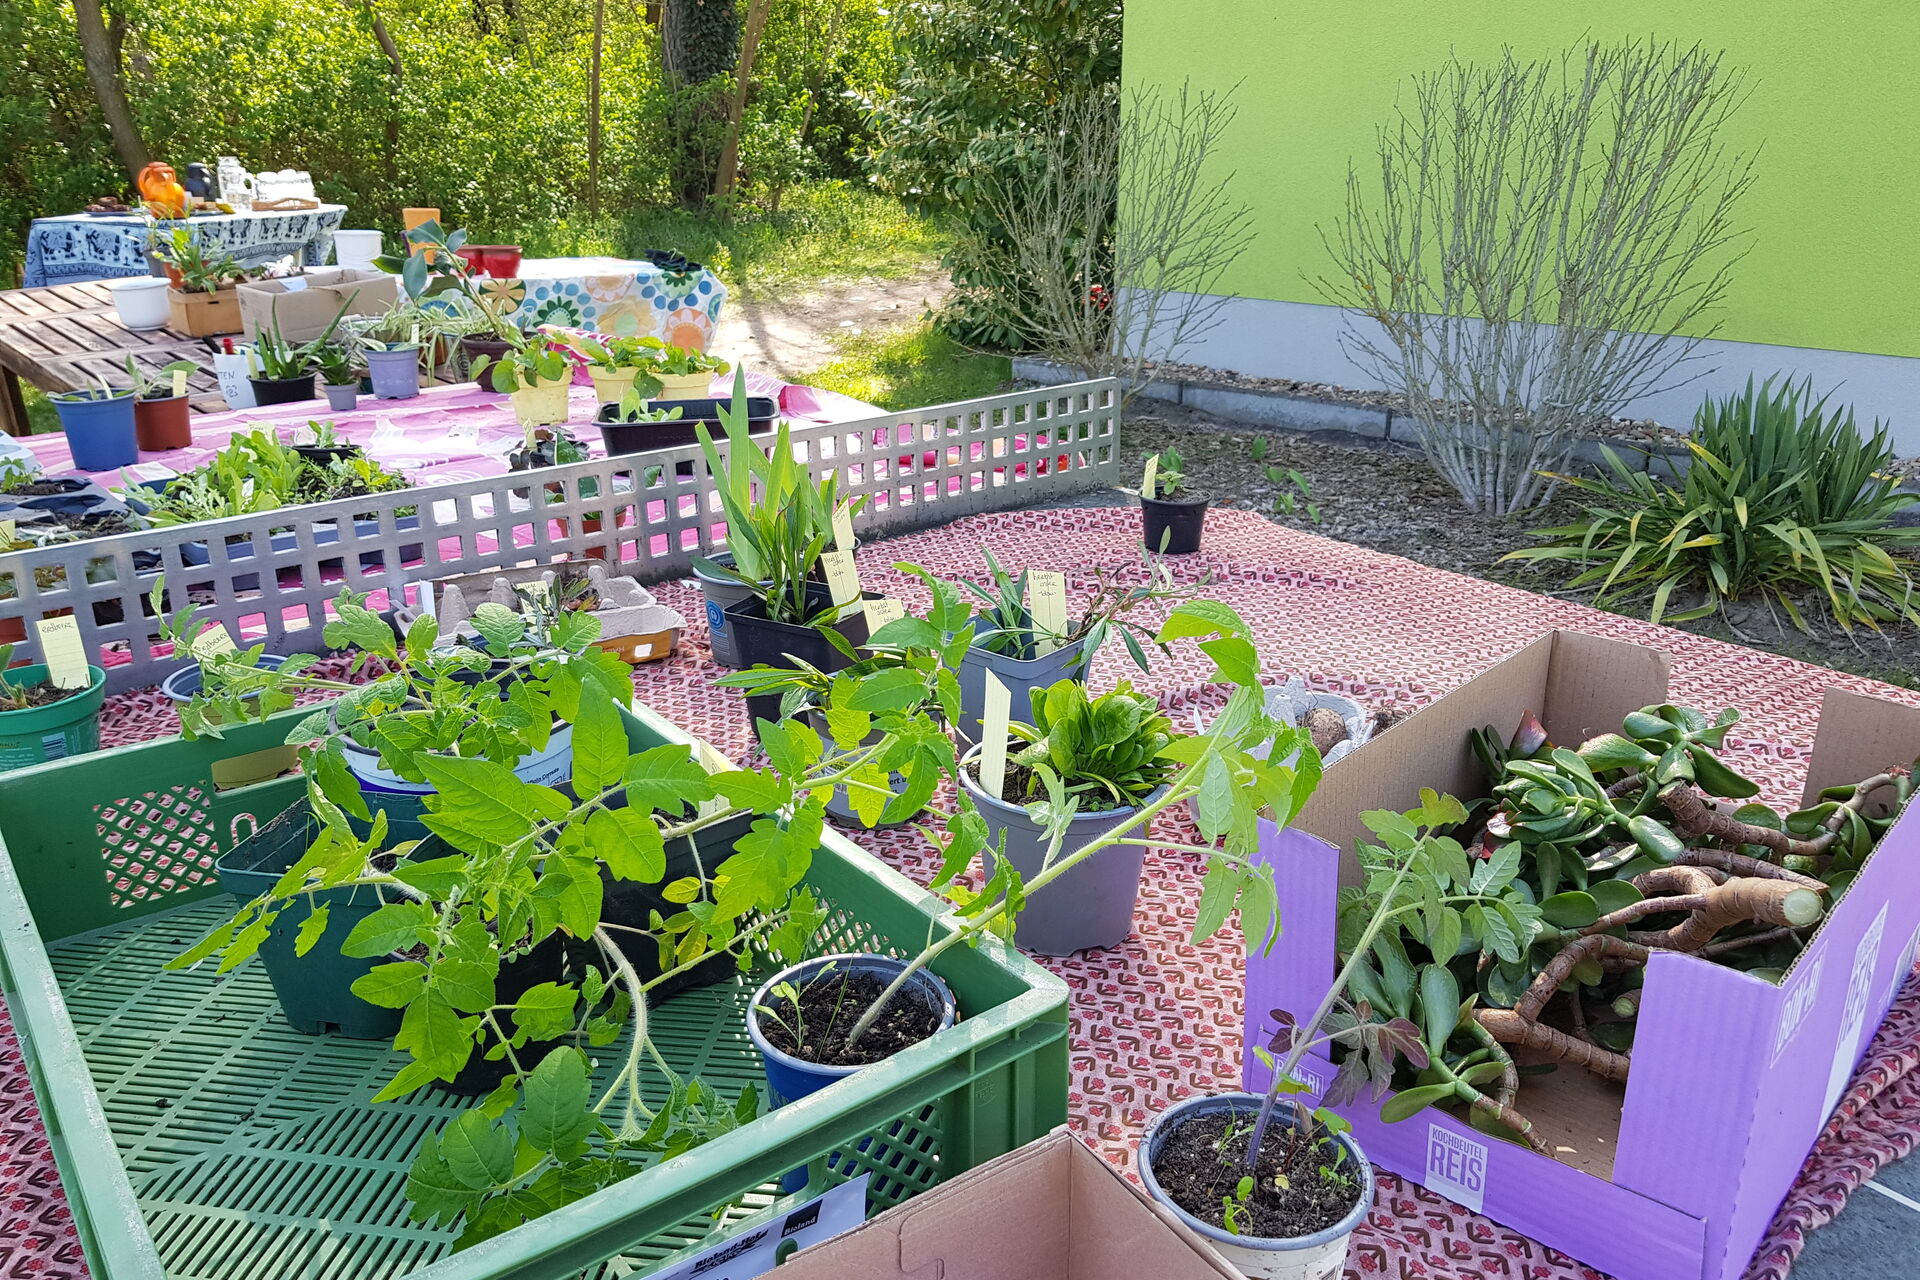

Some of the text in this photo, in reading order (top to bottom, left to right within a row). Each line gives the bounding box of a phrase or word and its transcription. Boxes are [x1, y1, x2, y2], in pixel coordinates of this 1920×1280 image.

[1275, 1059, 1321, 1096] BN-RI
[1431, 1127, 1484, 1160] KOCHBEUTEL
[1429, 1140, 1483, 1192] REIS
[783, 1215, 817, 1236] Bioland
